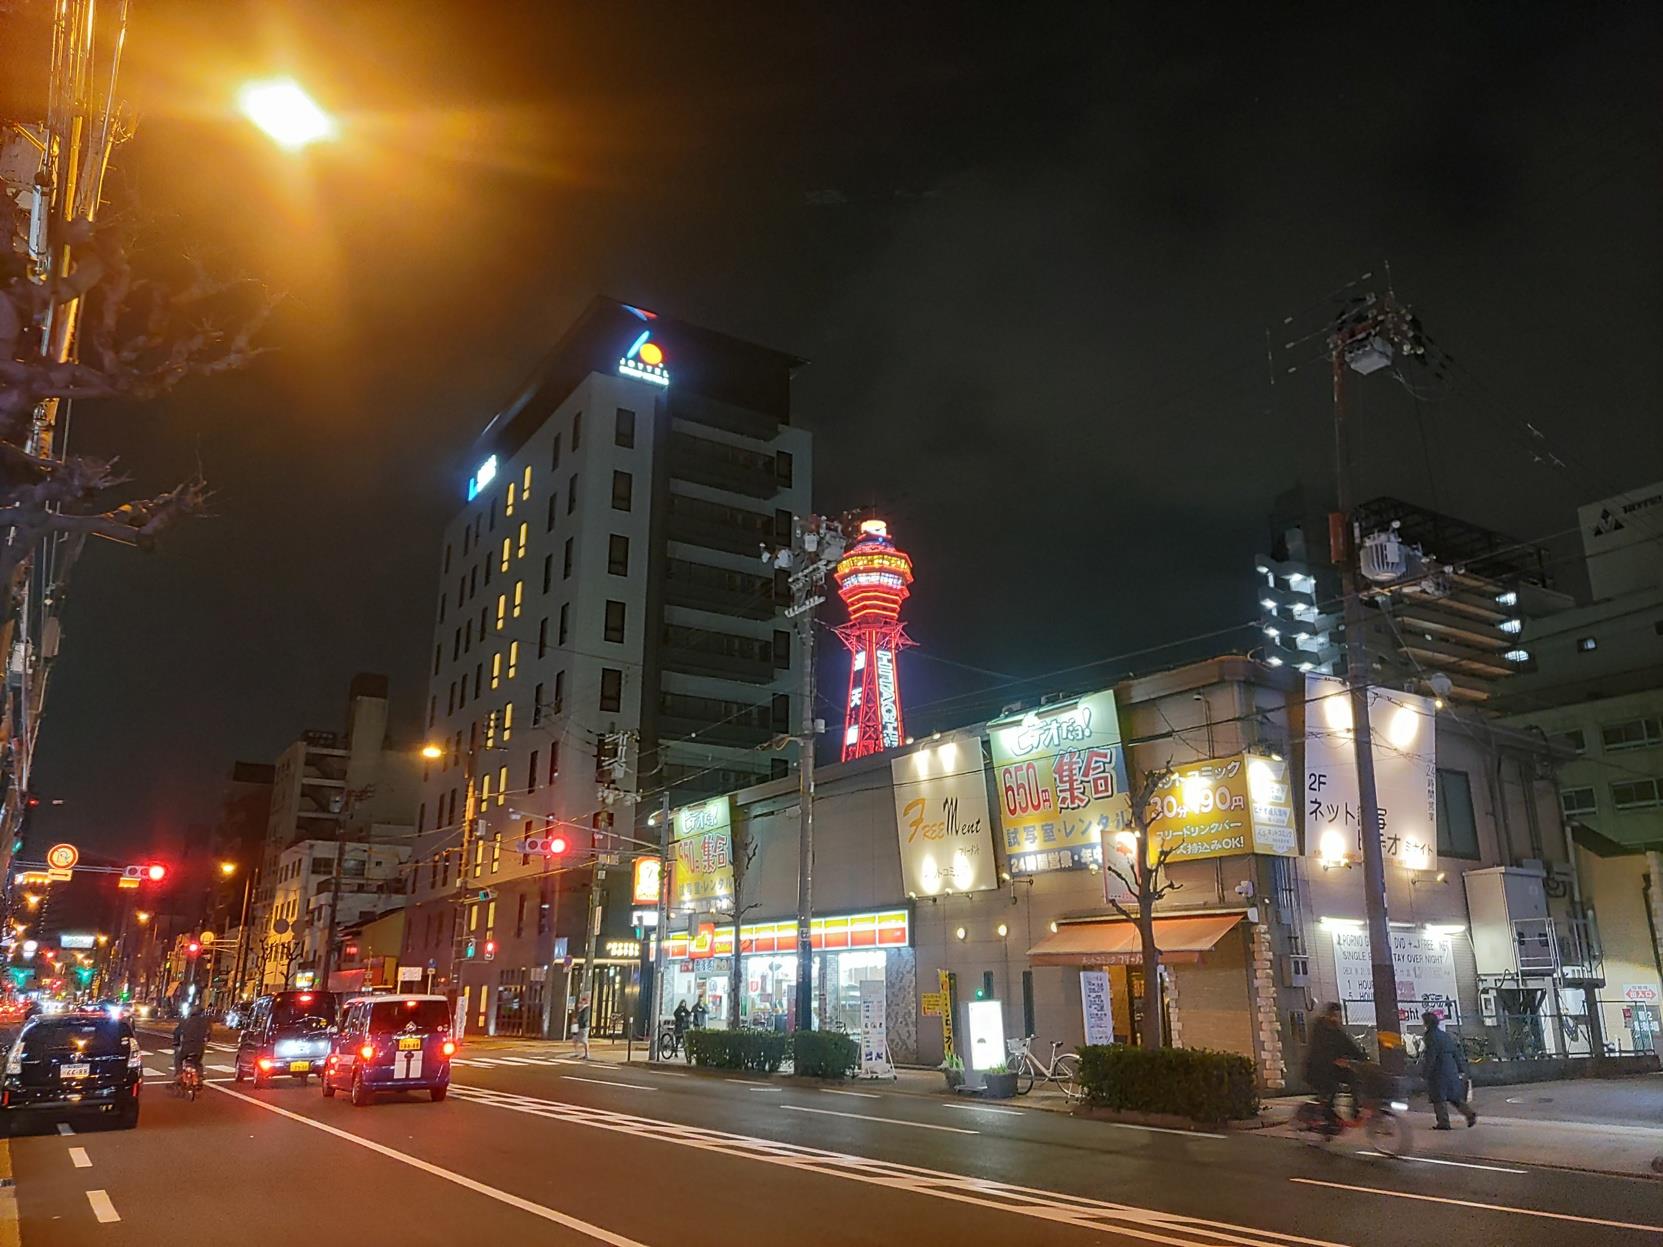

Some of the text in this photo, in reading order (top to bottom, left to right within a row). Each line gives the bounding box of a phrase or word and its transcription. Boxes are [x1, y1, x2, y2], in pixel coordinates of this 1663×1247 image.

[876, 650, 899, 746] HITACHI
[1003, 746, 1112, 817] 650円 集合
[1152, 761, 1241, 789] ットコミック
[1309, 772, 1327, 792] 2F
[1193, 786, 1244, 814] 90円
[1393, 953, 1405, 963] TAY
[1357, 980, 1374, 991] HOU
